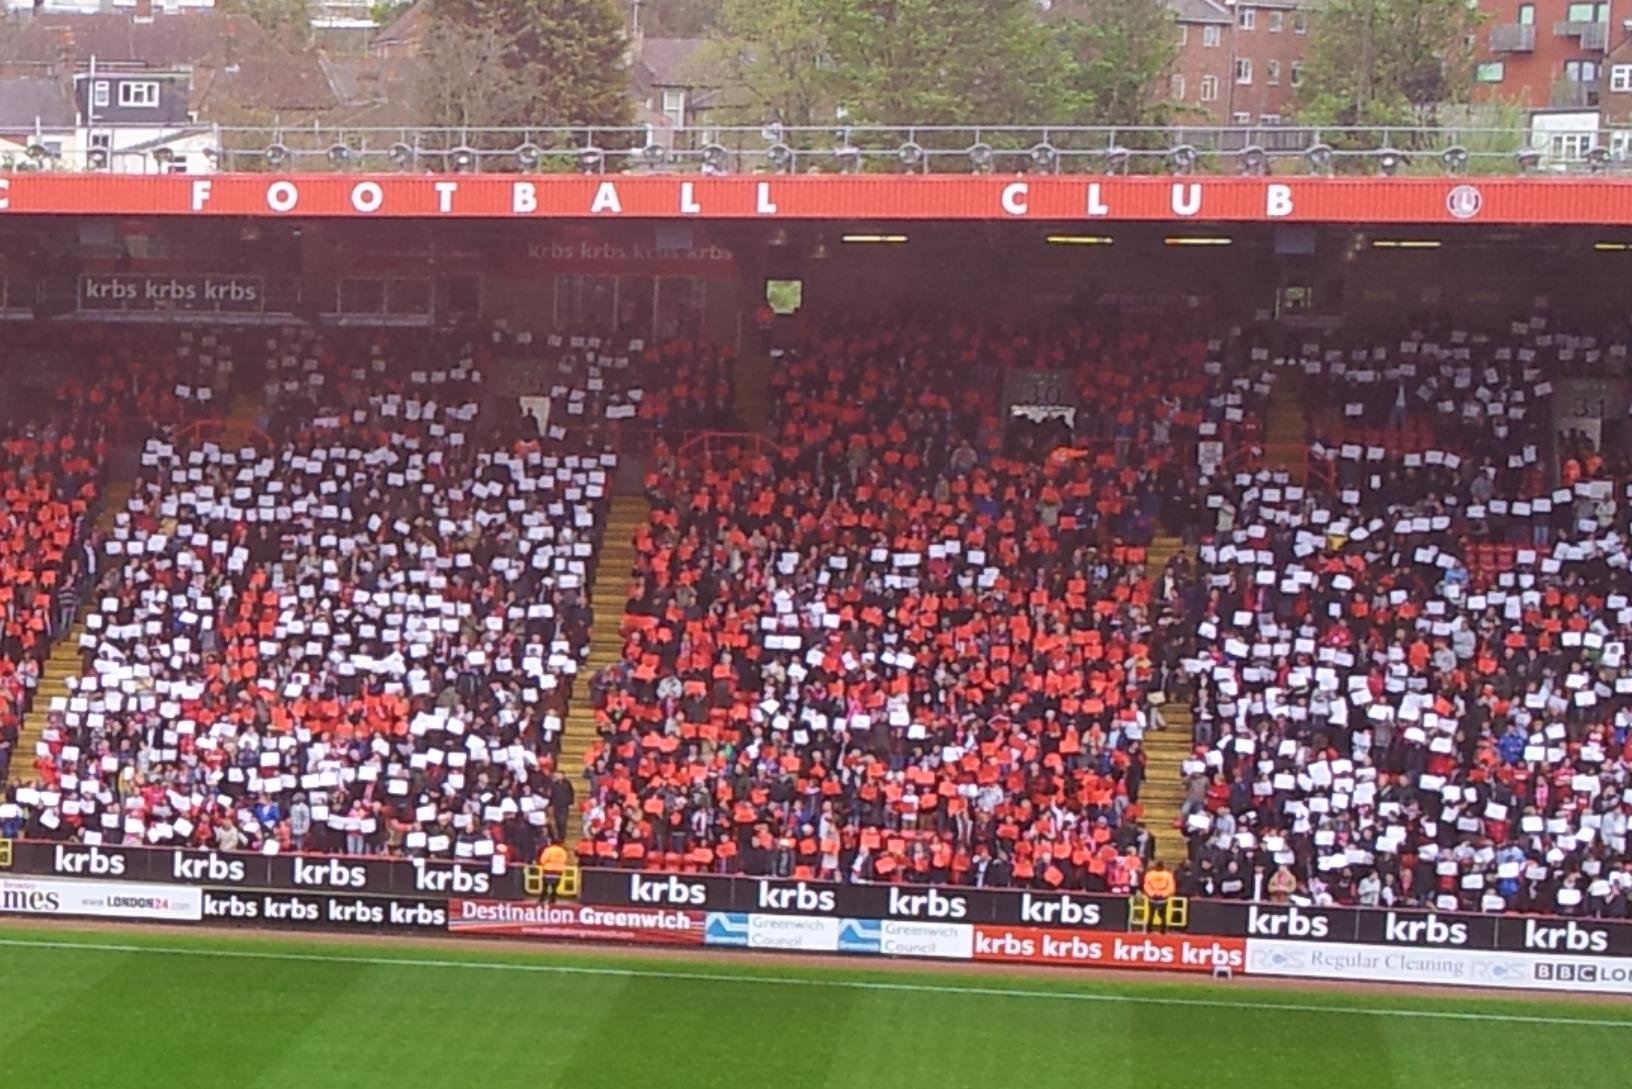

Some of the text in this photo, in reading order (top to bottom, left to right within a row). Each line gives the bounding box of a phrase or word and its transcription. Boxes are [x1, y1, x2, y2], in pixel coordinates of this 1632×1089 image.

[191, 180, 777, 214] FOOTBALL
[1000, 182, 1294, 217] CLUB
[86, 279, 256, 301] krbs krbs krbs
[55, 844, 125, 875] krbs
[173, 851, 245, 881] krbs
[294, 857, 366, 887] krbs
[416, 862, 489, 893] krbs
[630, 873, 706, 904] krbs
[204, 894, 446, 926] krbs krbs krbs krbs
[759, 880, 836, 911] krbs
[889, 886, 967, 918] krbs
[1021, 892, 1101, 925] krbs
[462, 901, 691, 930] Destination Greenwich
[751, 917, 825, 932] Greenwich
[885, 923, 959, 938] Greenwich
[1248, 905, 1329, 937] krbs
[1386, 912, 1467, 944] krbs
[751, 932, 804, 947] Council
[884, 939, 937, 954] Council
[975, 931, 1243, 966] krbs krbs krbs krbs
[1524, 919, 1608, 952] krbs
[1311, 948, 1379, 968] Regular
[1385, 955, 1464, 977] Cleaning
[1535, 962, 1632, 982] BBC LO
